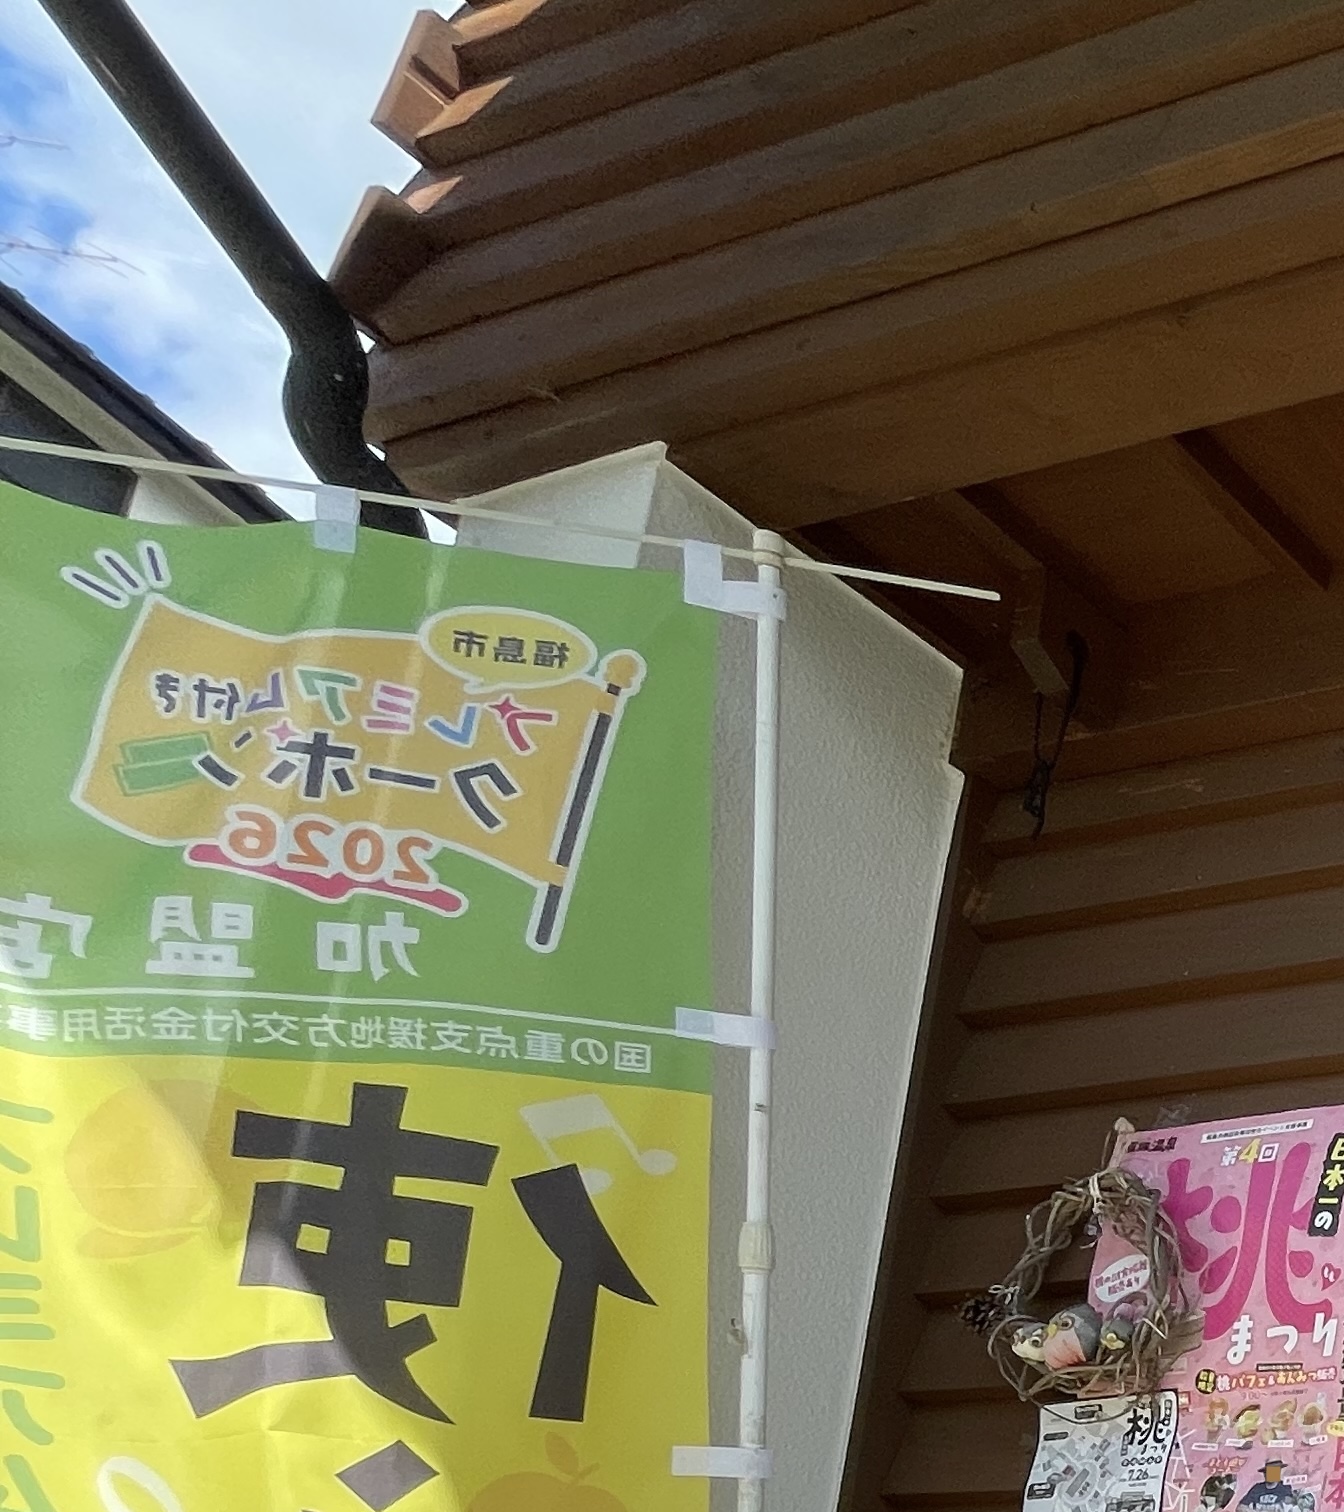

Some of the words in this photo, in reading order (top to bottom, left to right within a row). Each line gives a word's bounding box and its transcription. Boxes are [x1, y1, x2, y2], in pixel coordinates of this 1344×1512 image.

[1219, 1137, 1280, 1167] 第4回
[1162, 1141, 1334, 1341] 桃
[1225, 1312, 1340, 1366] まつり
